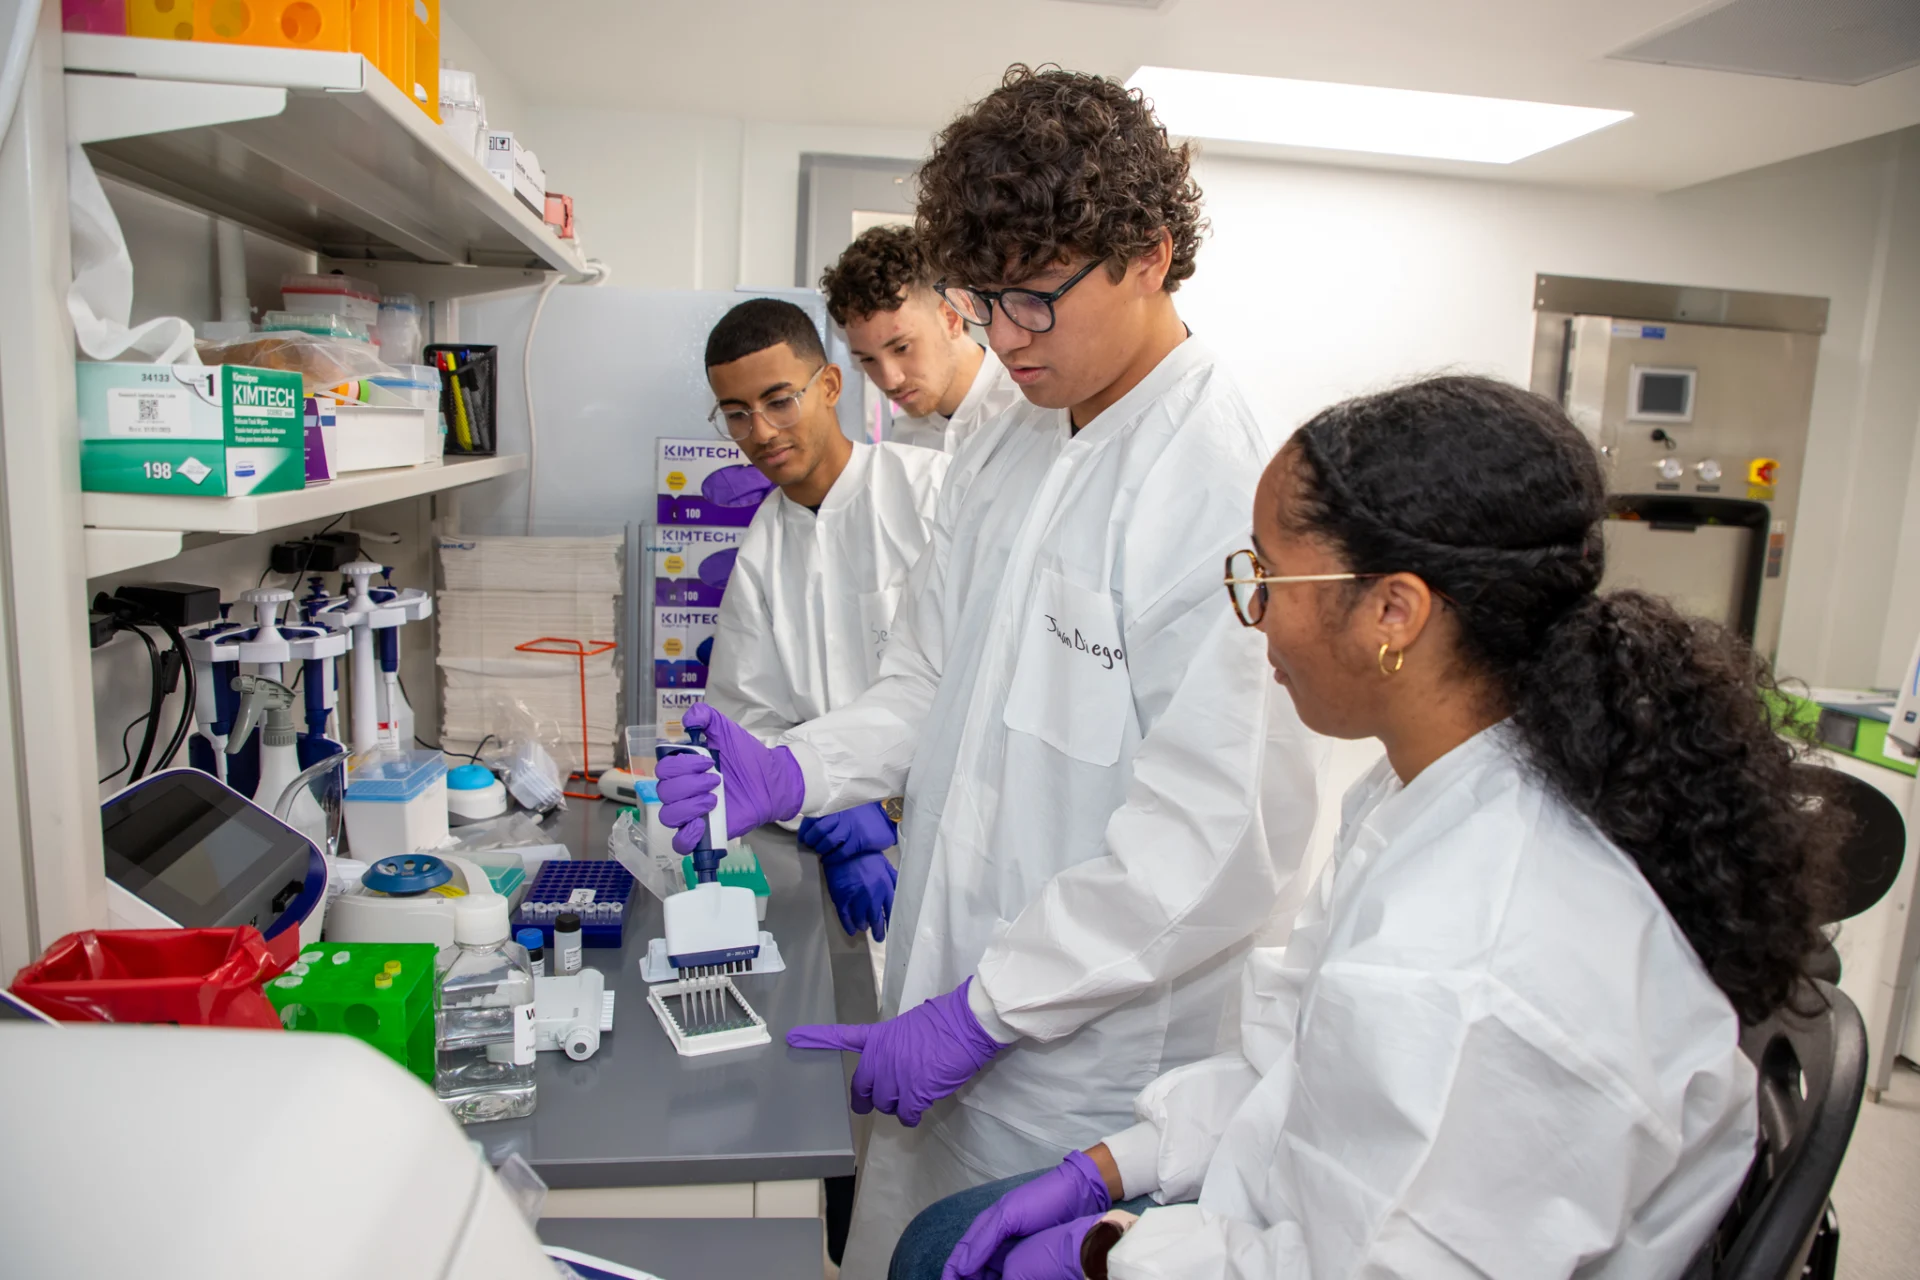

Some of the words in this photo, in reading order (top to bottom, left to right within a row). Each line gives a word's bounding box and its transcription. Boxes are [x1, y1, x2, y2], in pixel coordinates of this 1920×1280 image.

[141, 373, 170, 382] 34133
[206, 373, 214, 397] 1
[233, 383, 295, 408] KIMTECH
[664, 445, 739, 459] KIMTECH
[143, 462, 172, 479] 198
[685, 508, 701, 519] 100
[662, 530, 736, 543] KIMTECH
[684, 591, 698, 601] 100
[1075, 628, 1123, 670] Diego
[681, 672, 697, 683] 200
[662, 694, 705, 705] KIMT
